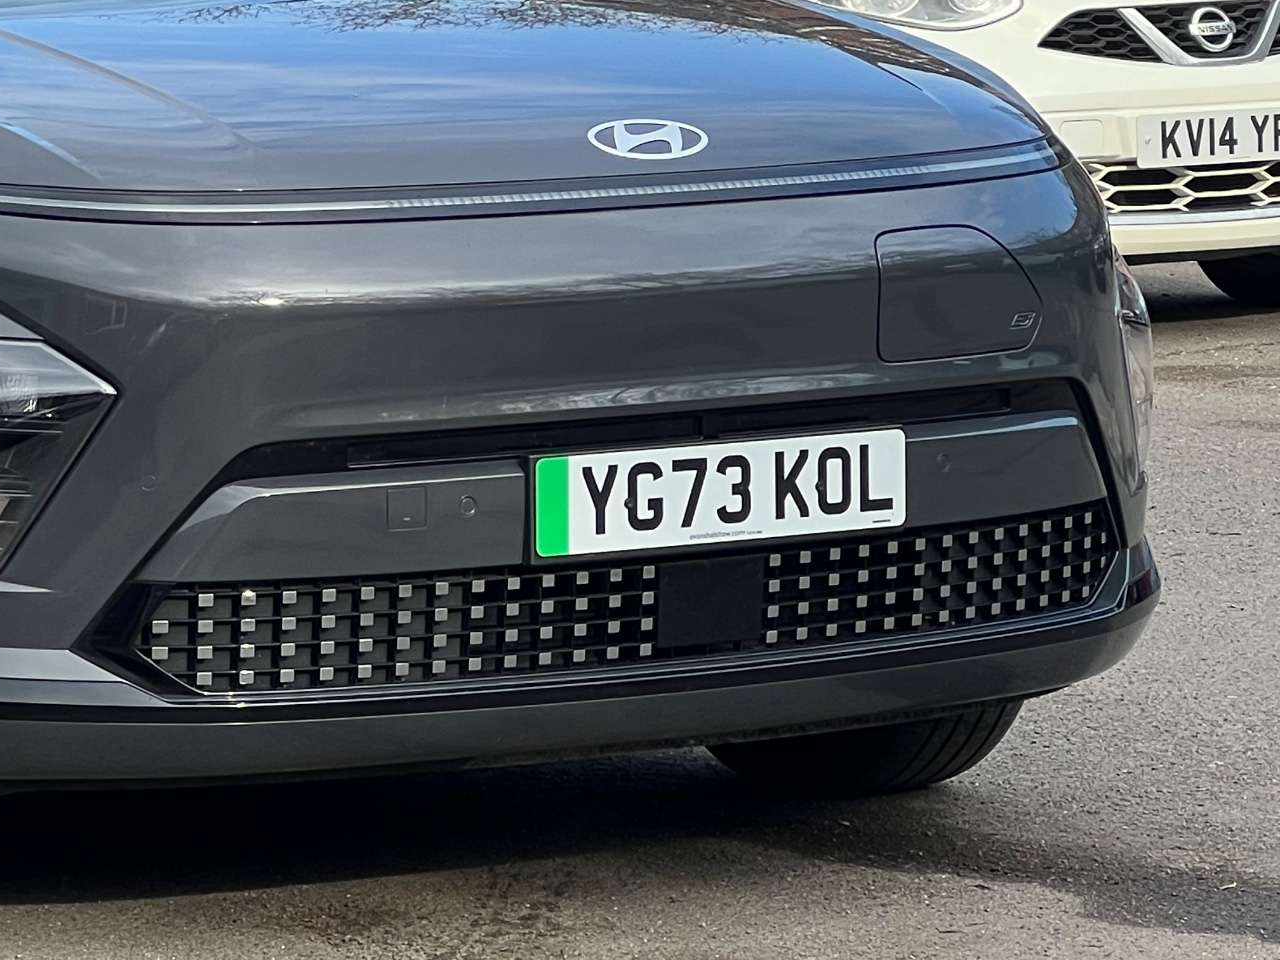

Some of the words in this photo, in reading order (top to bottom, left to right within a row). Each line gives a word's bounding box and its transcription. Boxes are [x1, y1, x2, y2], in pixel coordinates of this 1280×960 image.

[1198, 23, 1233, 33] NISSAN
[1160, 117, 1239, 159] KV14
[581, 454, 752, 536] YG73
[774, 444, 894, 520] KOL
